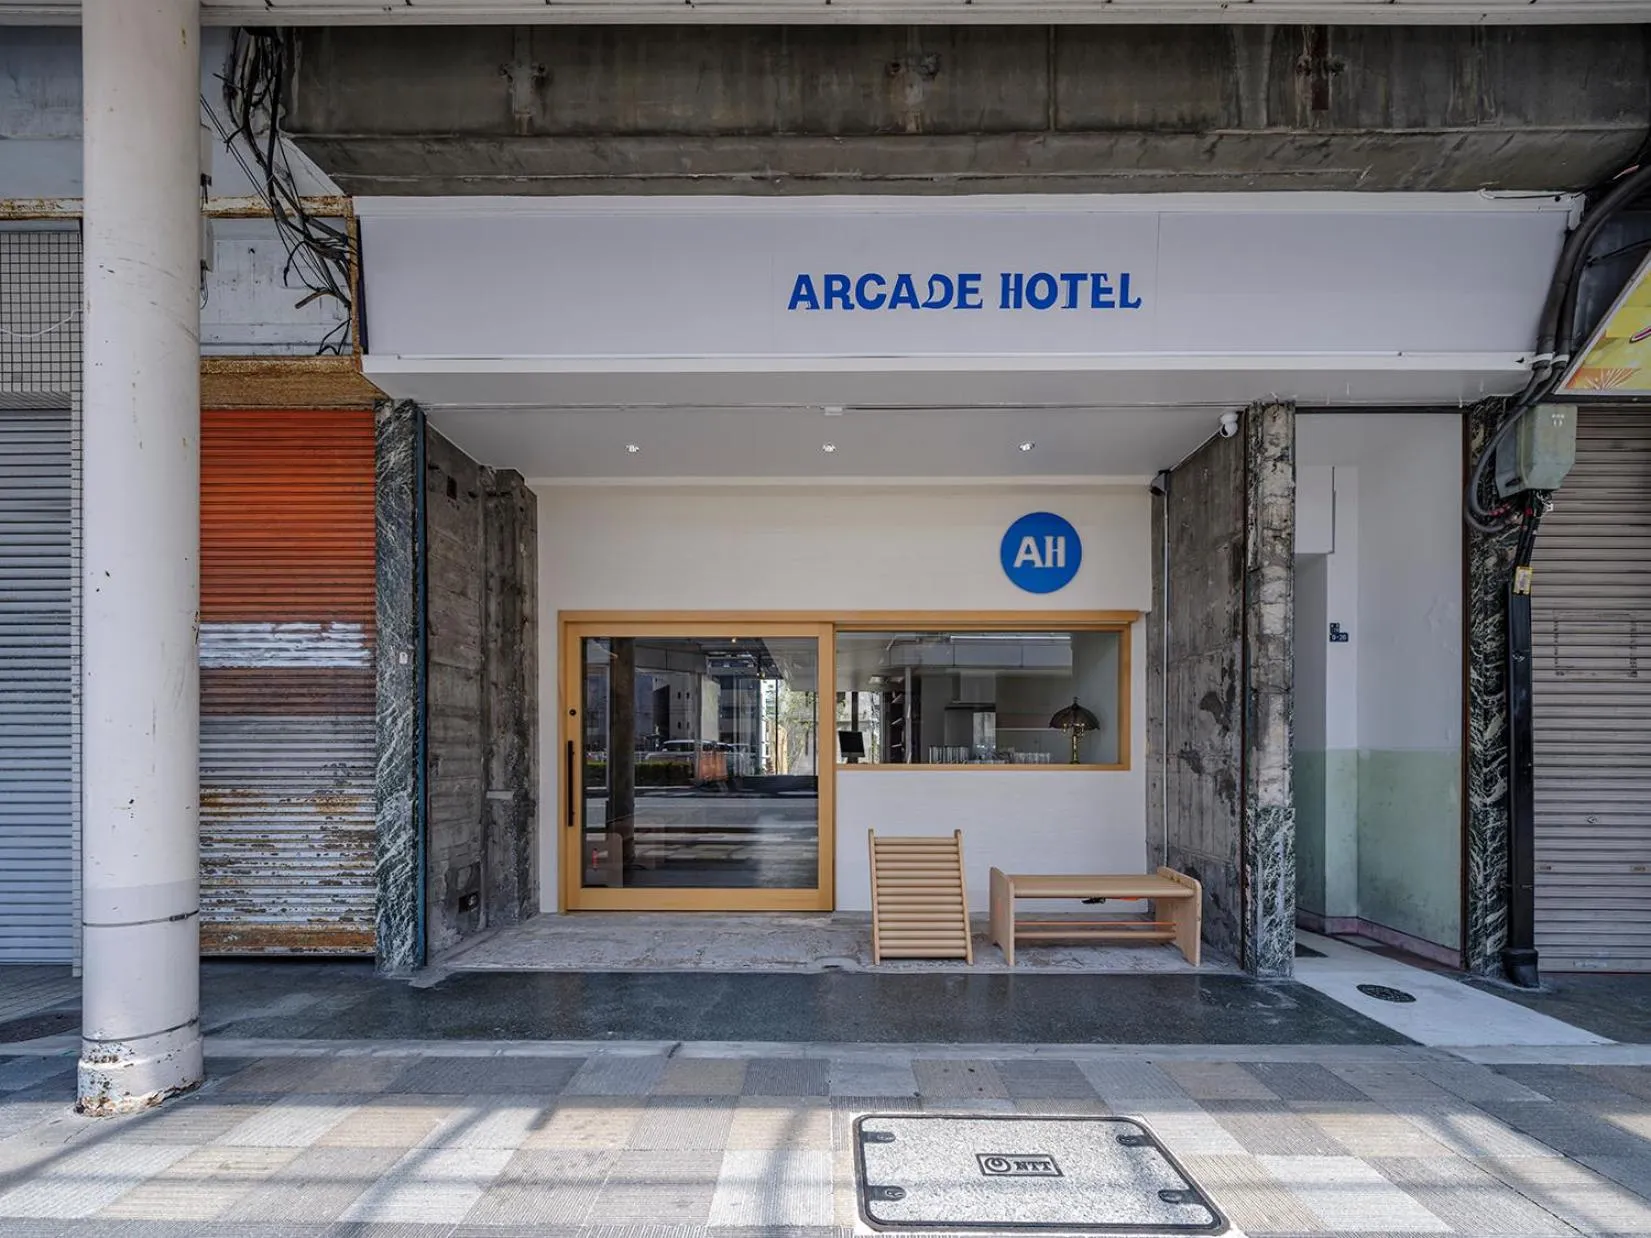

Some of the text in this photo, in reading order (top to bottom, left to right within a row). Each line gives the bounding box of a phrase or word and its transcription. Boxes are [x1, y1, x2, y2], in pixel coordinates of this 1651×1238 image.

[787, 272, 1142, 310] ARCADE HOTEL
[1013, 535, 1066, 568] AH
[1013, 1161, 1052, 1171] NTT
